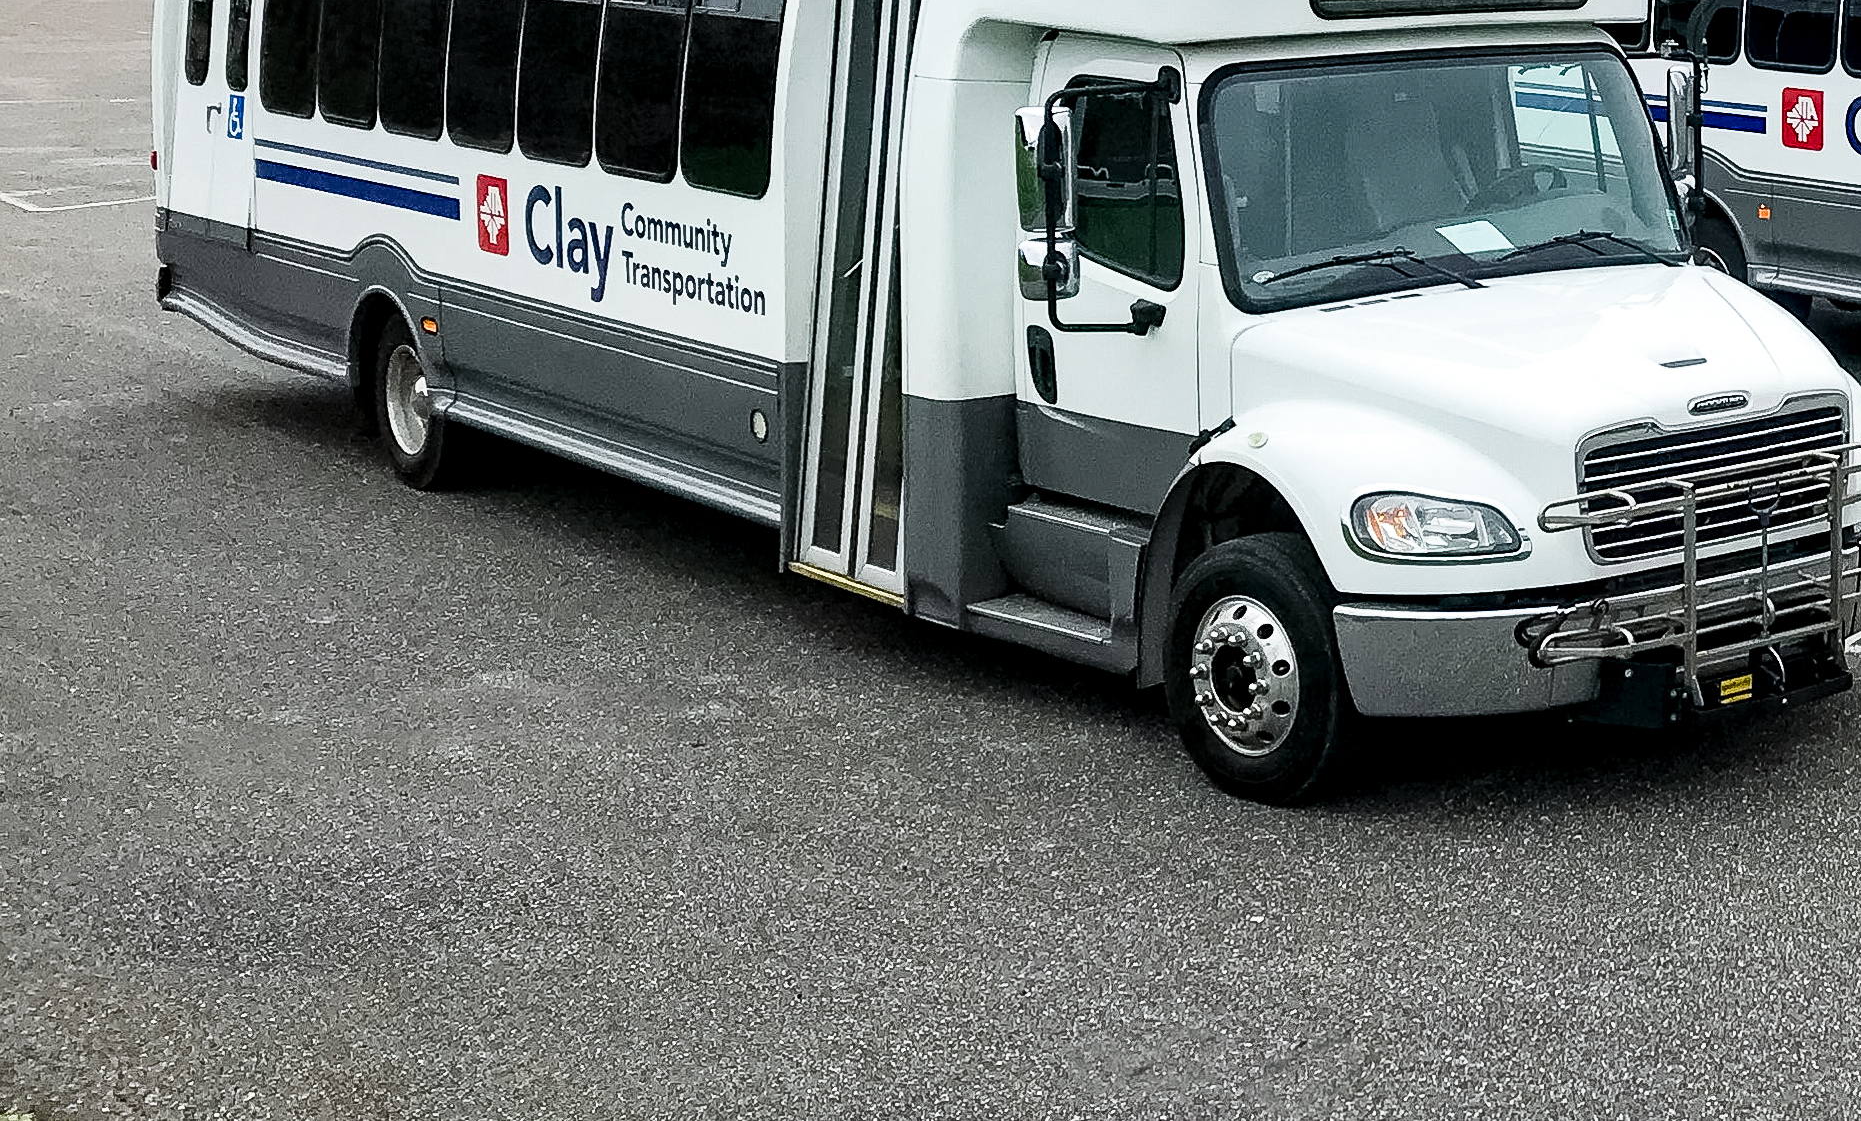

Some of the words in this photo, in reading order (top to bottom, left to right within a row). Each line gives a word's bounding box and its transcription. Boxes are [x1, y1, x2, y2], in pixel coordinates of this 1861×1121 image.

[525, 184, 614, 303] Clay
[621, 202, 732, 267] Community
[621, 250, 766, 315] Transportation
